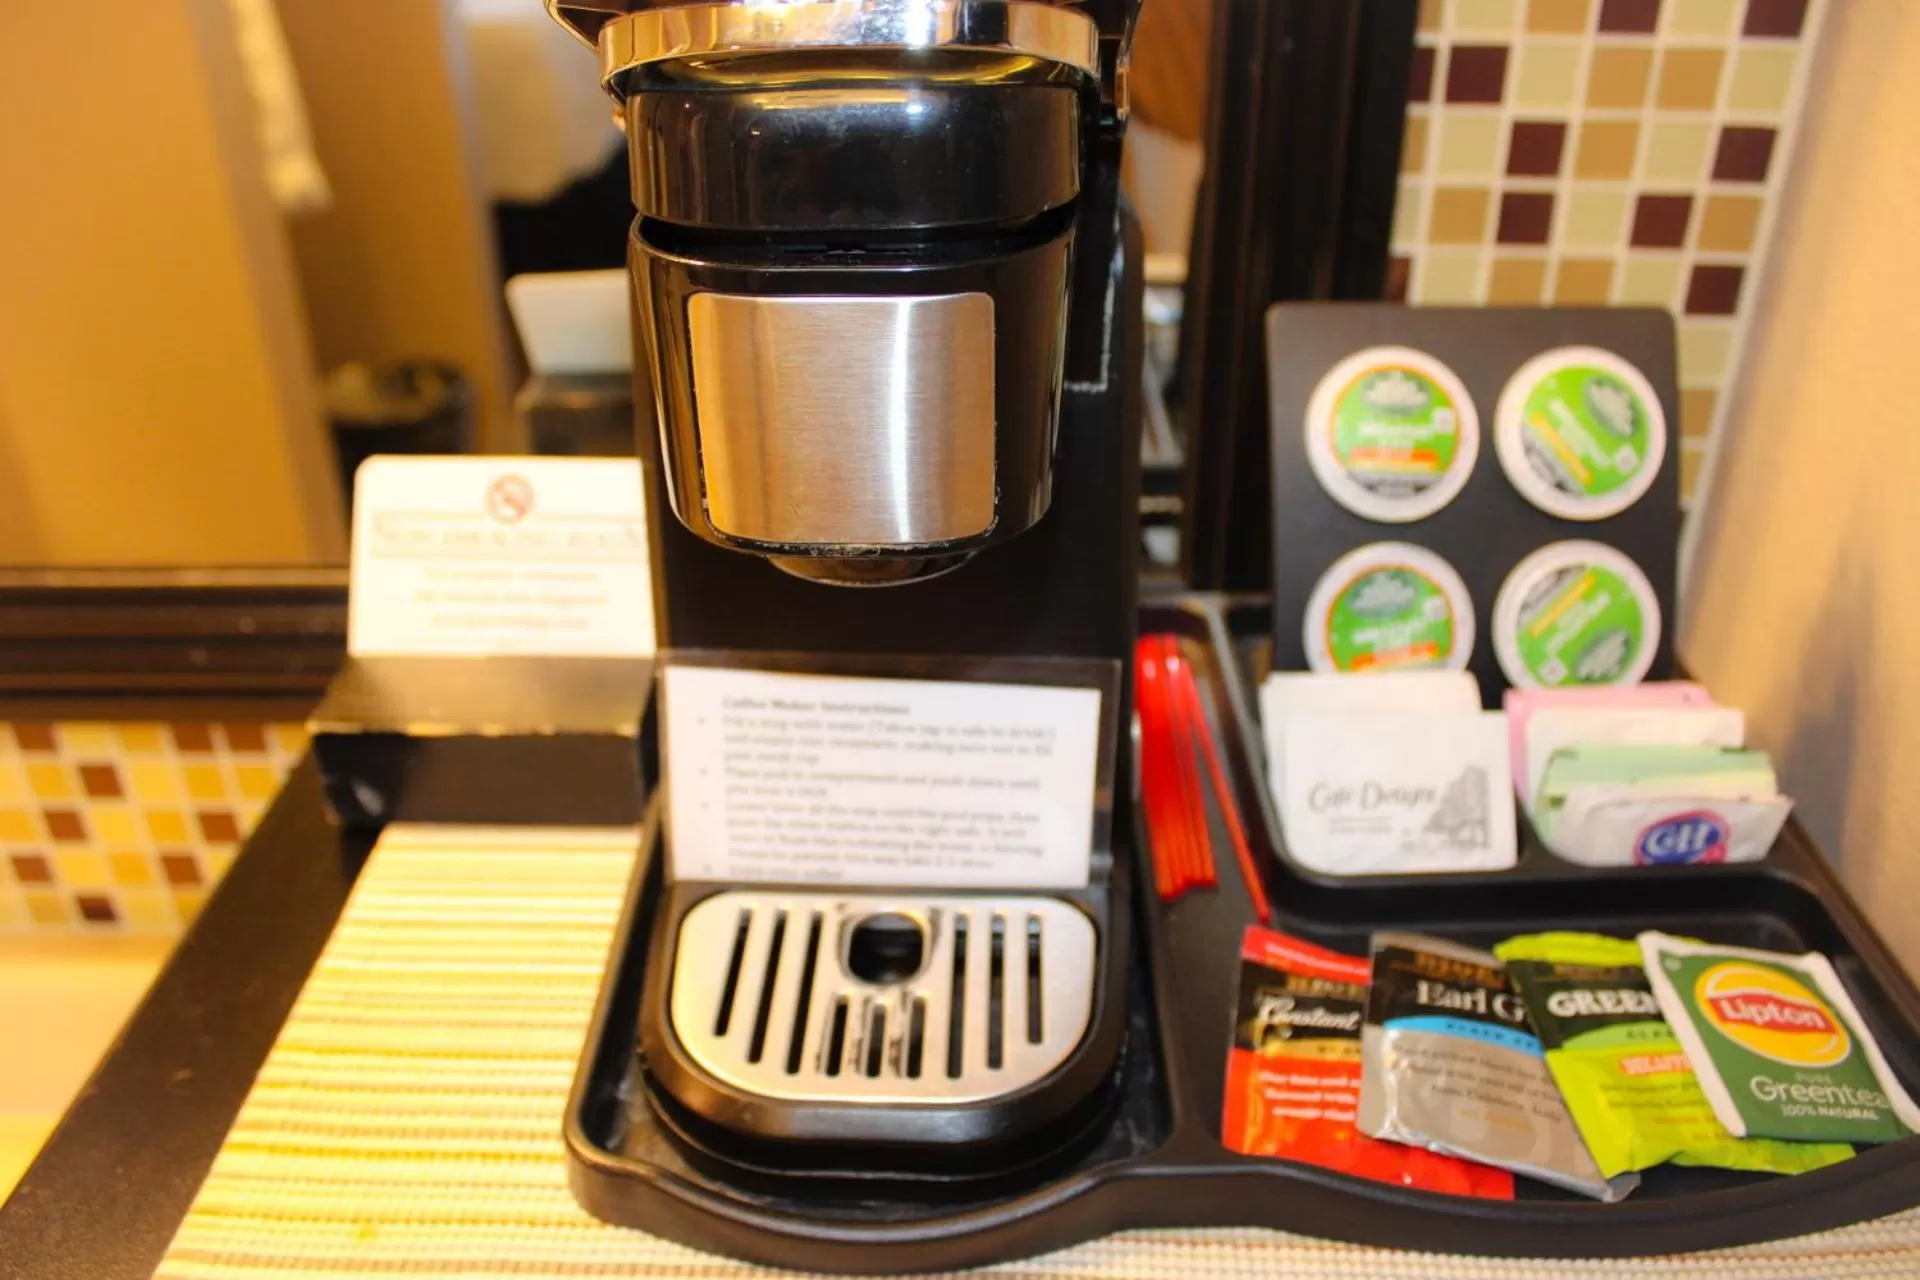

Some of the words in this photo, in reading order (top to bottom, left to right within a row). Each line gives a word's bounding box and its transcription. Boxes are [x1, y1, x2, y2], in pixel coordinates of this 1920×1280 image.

[1416, 980, 1488, 1014] Earl
[1492, 993, 1526, 1022] G
[1547, 989, 1660, 1017] GREEN
[1719, 998, 1827, 1030] Lipton
